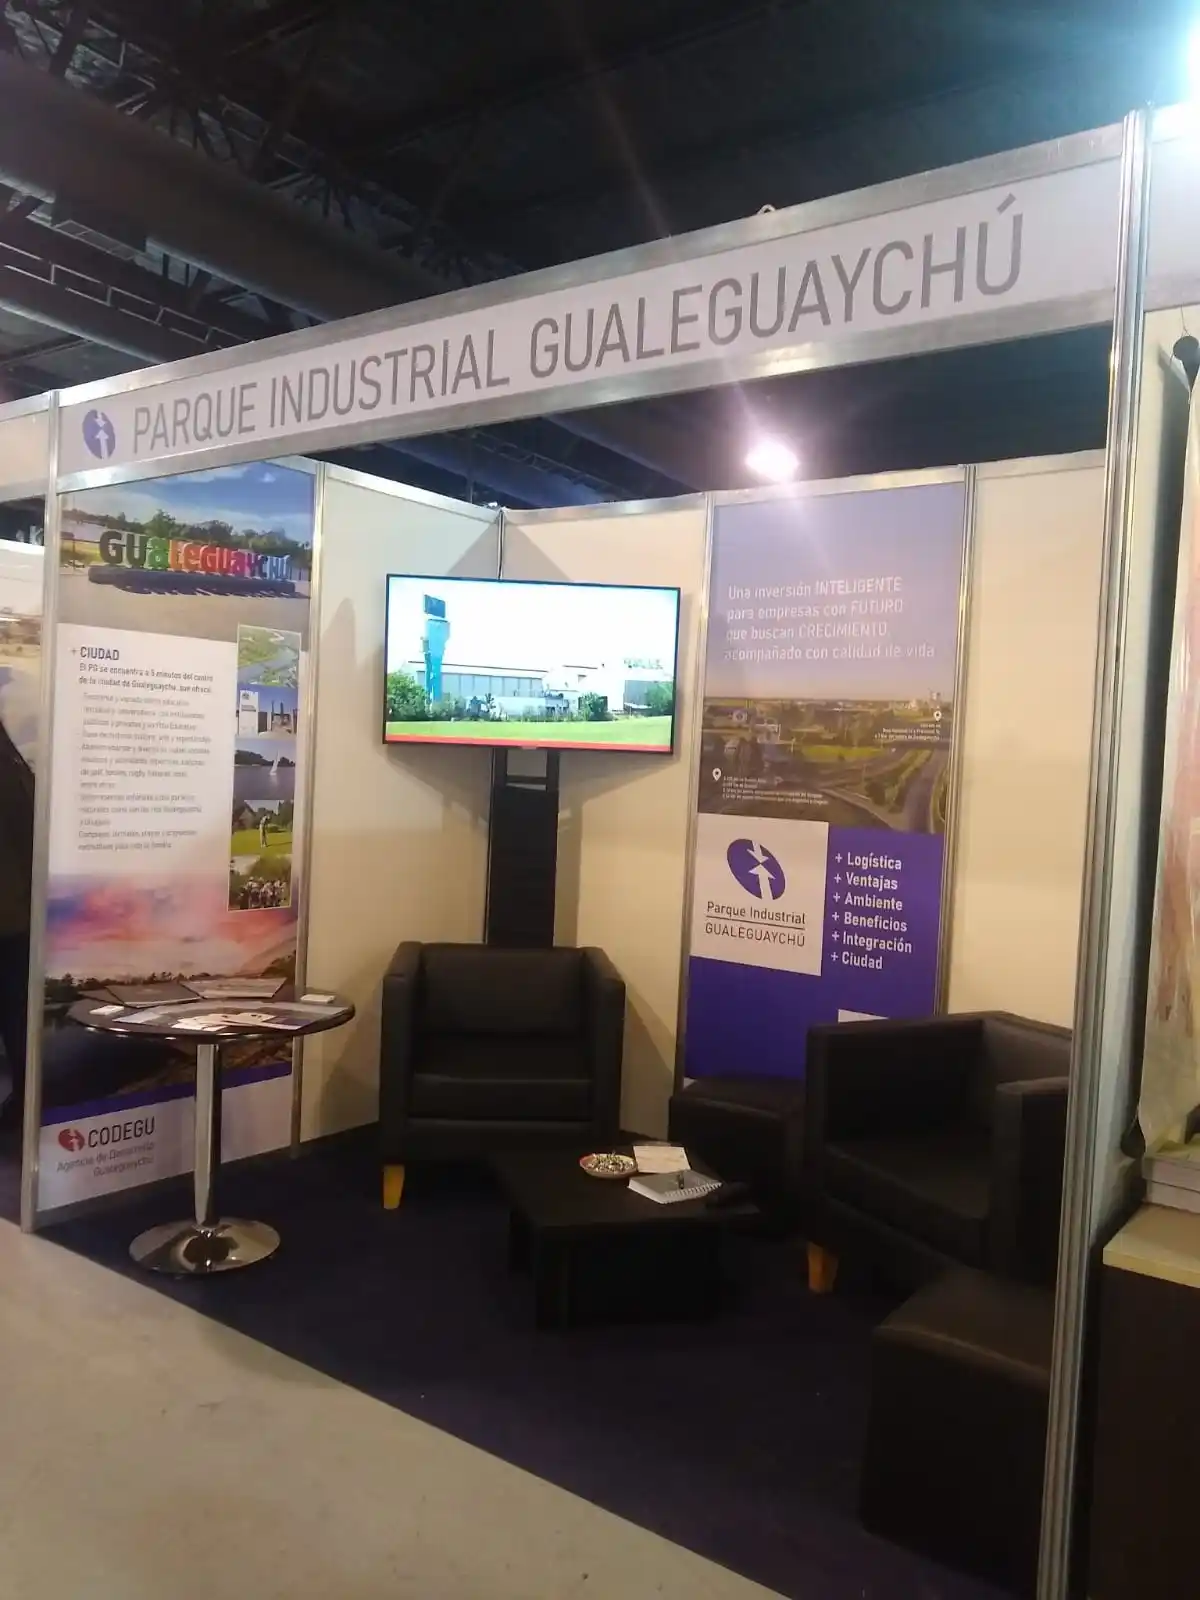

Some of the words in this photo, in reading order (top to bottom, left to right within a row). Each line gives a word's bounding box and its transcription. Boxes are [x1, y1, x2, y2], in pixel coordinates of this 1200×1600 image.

[133, 383, 257, 454] PARQUE
[269, 328, 510, 428] INDUSTRIAL
[529, 193, 1024, 378] GUALEGUAYCHÚ
[729, 586, 750, 601] Una
[755, 580, 812, 599] inversión
[815, 576, 903, 596] INTELIGENTE
[727, 608, 754, 624] para
[758, 604, 820, 622] empresas
[823, 604, 847, 618] con
[851, 598, 904, 616] FUTURO
[726, 628, 748, 644] que
[751, 625, 795, 641] buscan
[80, 646, 120, 661] CIUDAD
[725, 645, 801, 663] acompañado
[806, 646, 828, 660] con
[832, 645, 881, 660] calidad
[885, 643, 901, 659] de
[905, 642, 935, 658] vida
[847, 852, 902, 870] Logística
[846, 872, 898, 892] Ventajas
[844, 892, 903, 911] Ambiente
[707, 901, 746, 918] Parque
[750, 907, 806, 925] Industrial
[844, 912, 908, 932] Beneficios
[705, 922, 805, 947] GUALEGUAYCHÚ
[843, 932, 912, 954] Integración
[842, 951, 884, 970] Ciudad
[88, 1116, 155, 1148] CODEGU
